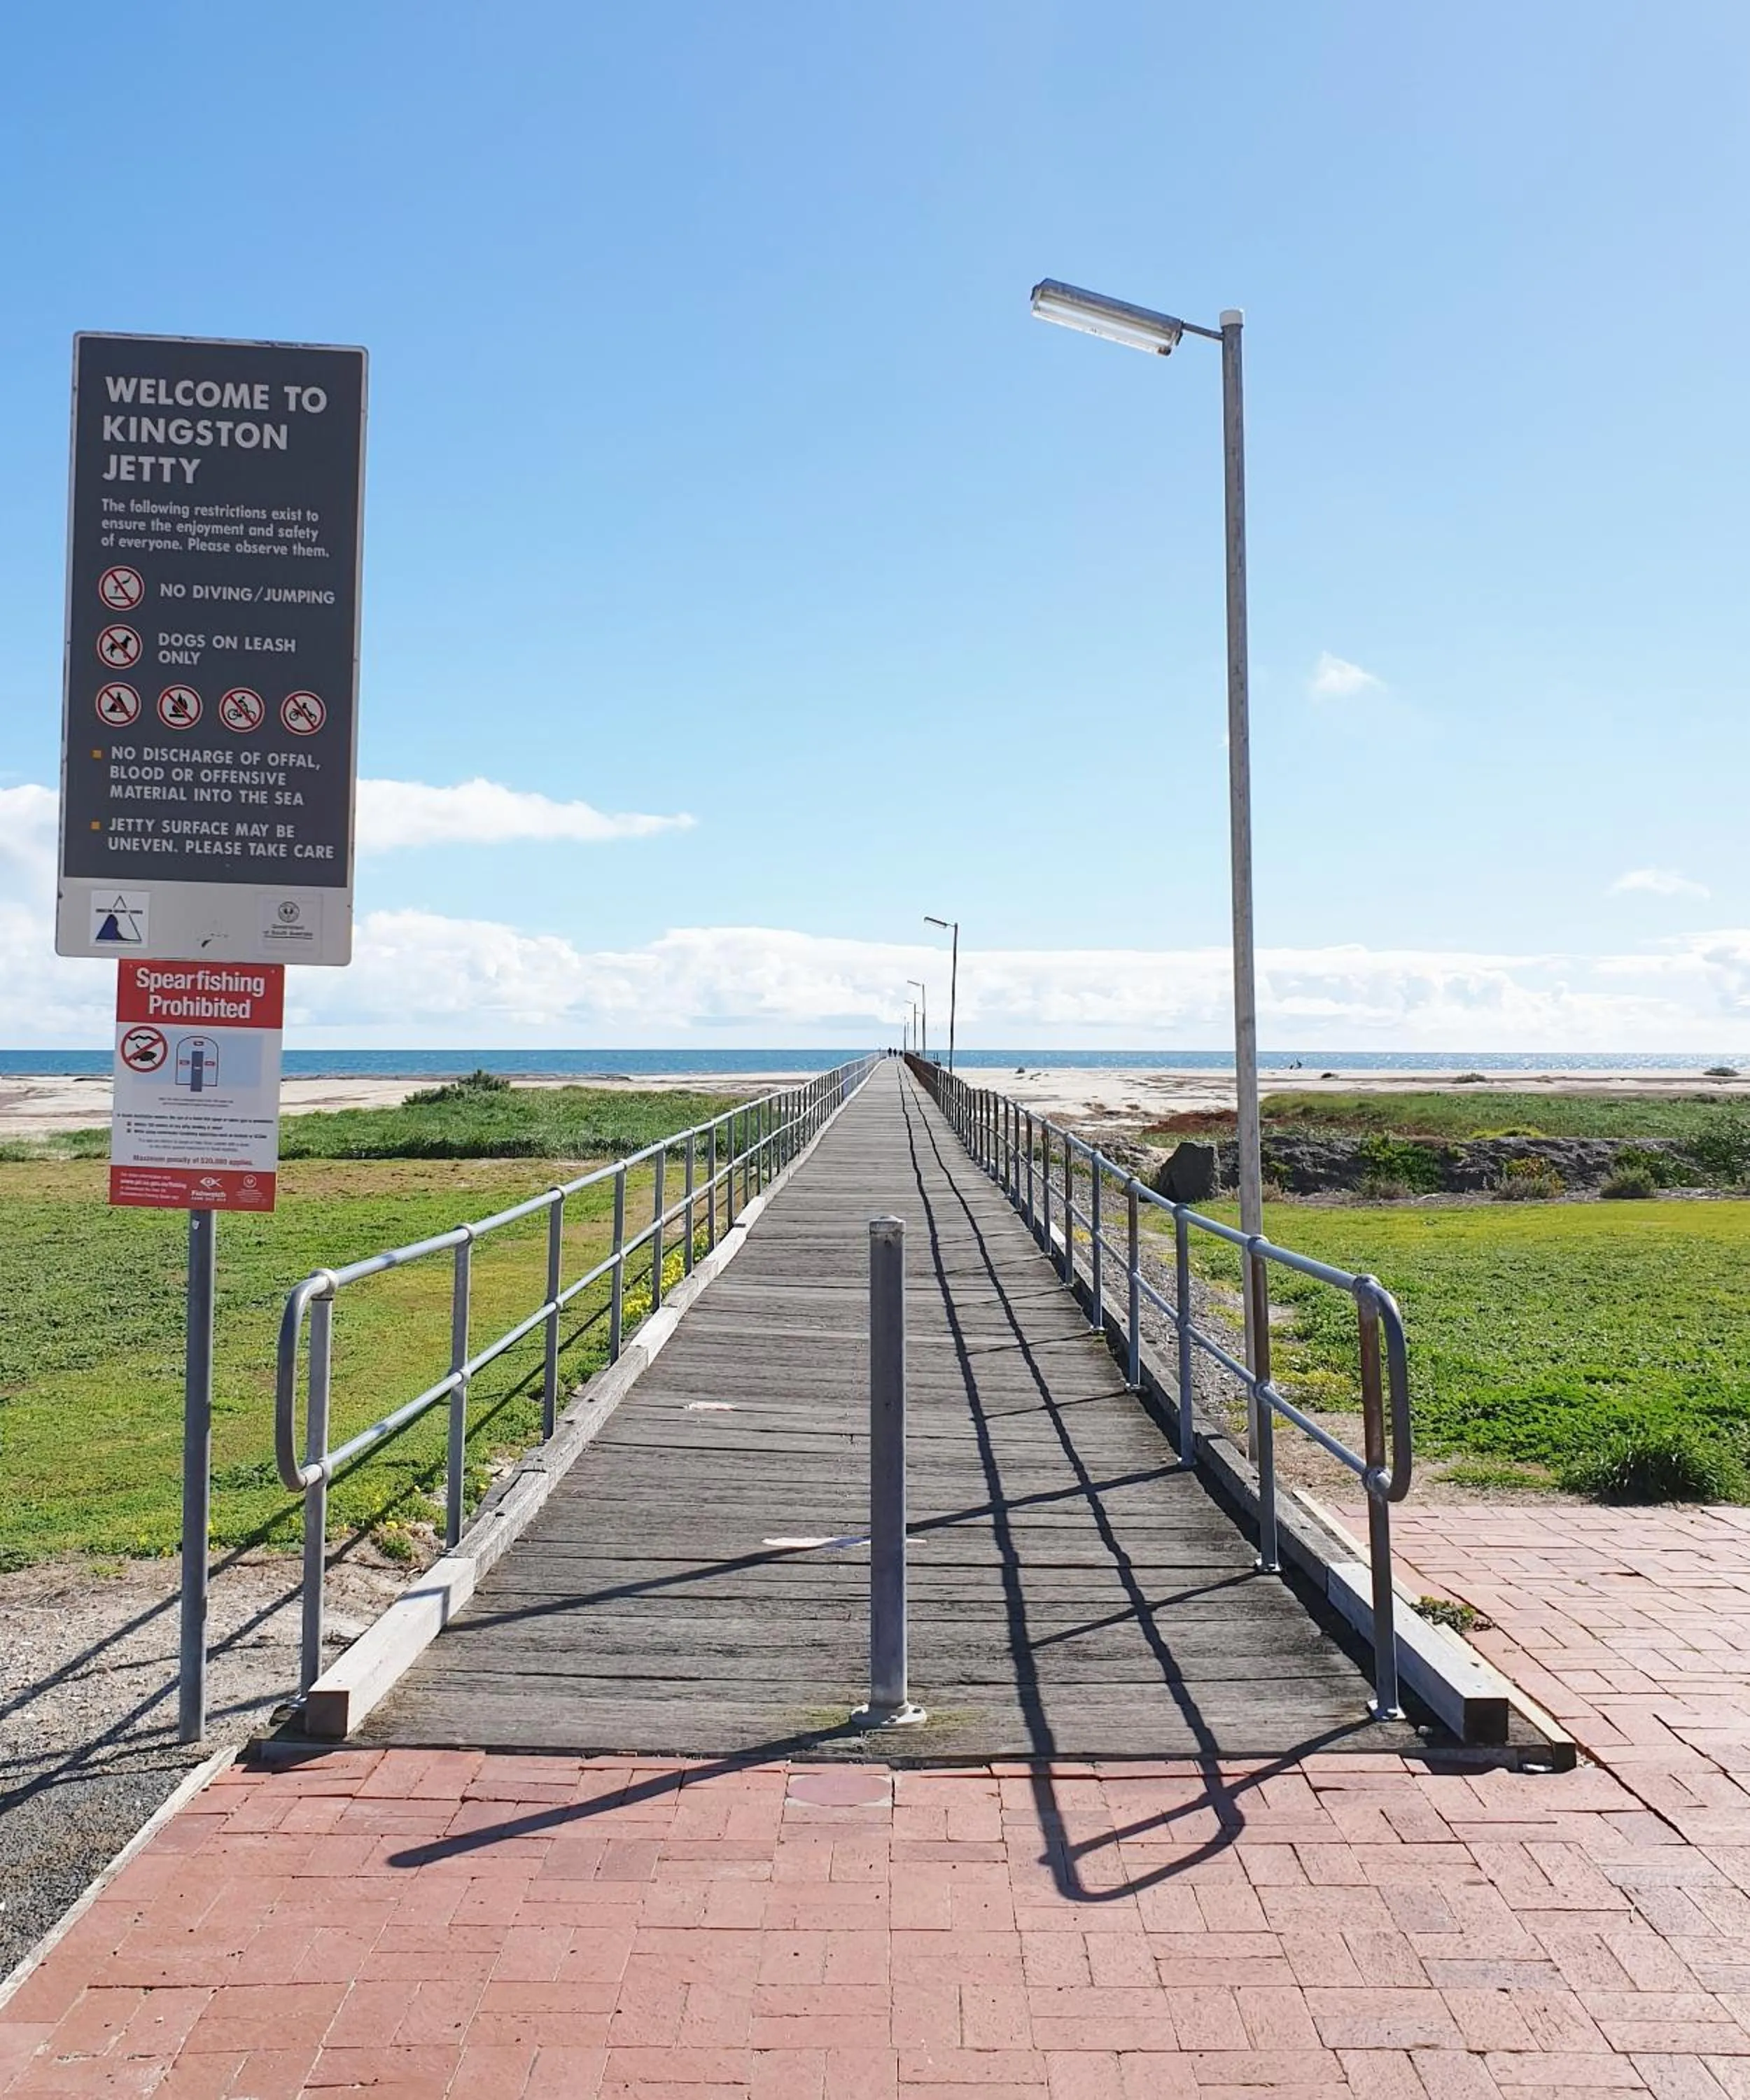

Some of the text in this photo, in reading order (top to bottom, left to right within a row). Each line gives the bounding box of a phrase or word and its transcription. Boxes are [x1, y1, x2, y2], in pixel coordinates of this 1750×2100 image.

[106, 376, 328, 413] WELCOME TO
[103, 416, 288, 450] KINGSTON
[102, 455, 201, 484] JETTY
[102, 498, 318, 522] The following restrictions exist to
[102, 519, 318, 542] ensure the enjoyment and safety
[101, 536, 329, 557] of everyone. Please observe them.
[160, 583, 335, 603] NO DIVING/JUMPING
[158, 634, 295, 652] DOGS ON LEASH
[158, 650, 201, 665] ONLY
[111, 747, 321, 770] NO DISCHARGE OF OFFAL,
[110, 766, 286, 785] BLOOD OR OFFENSIVE
[110, 786, 304, 806] MATERIAL INTO THE SEA
[108, 819, 295, 837] JETTY SURFACE MAY BE
[108, 837, 335, 859] UNEVEN. PLEASE TAKE CARE
[136, 967, 265, 997] Spearfishing
[148, 995, 251, 1018] Prohibited
